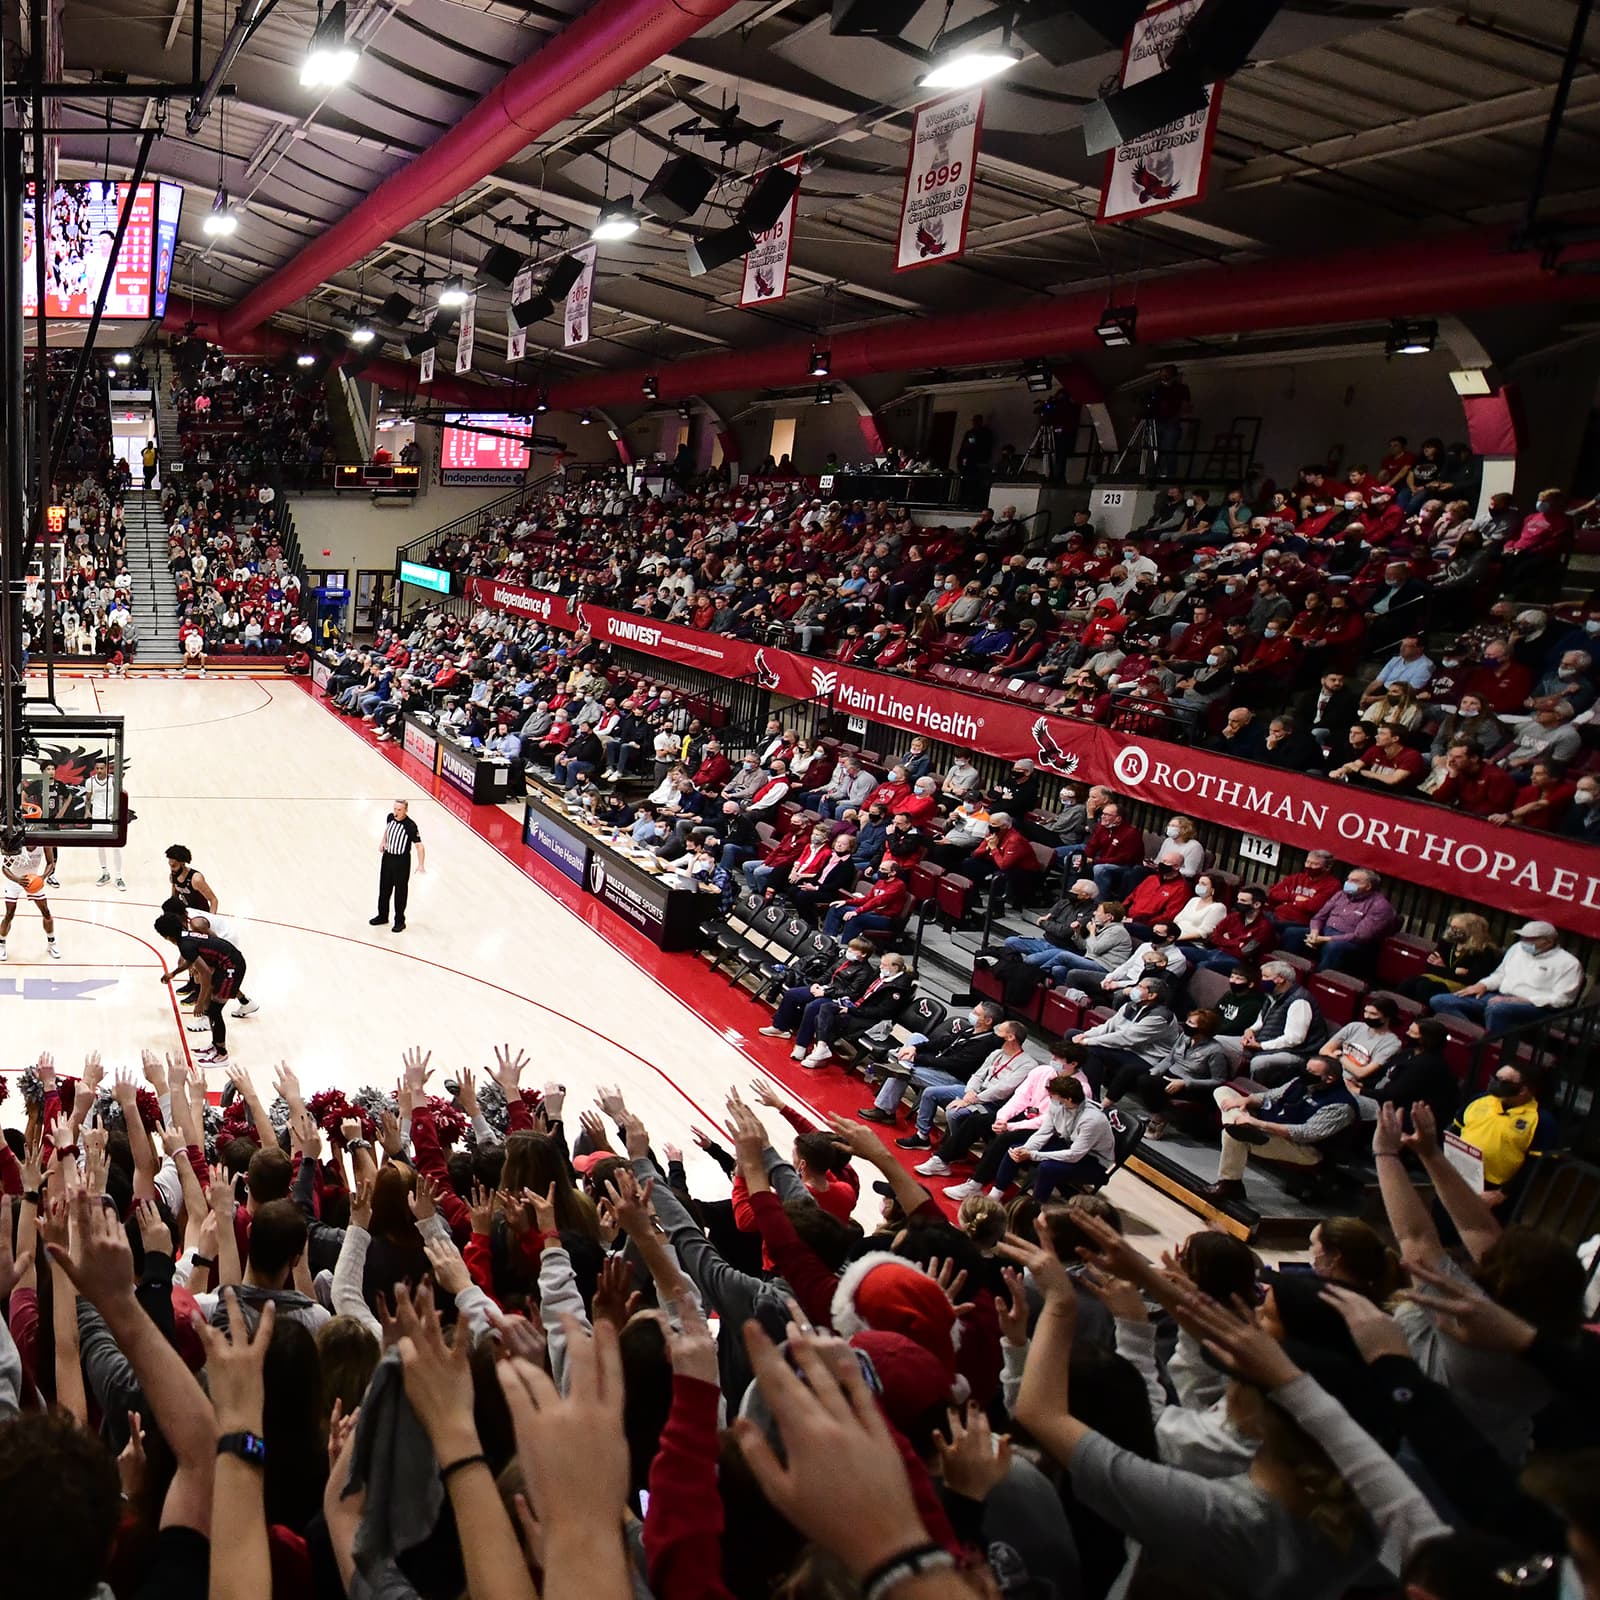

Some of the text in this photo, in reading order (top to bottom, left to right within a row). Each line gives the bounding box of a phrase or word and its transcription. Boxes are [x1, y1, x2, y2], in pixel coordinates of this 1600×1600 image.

[917, 113, 976, 144] BASKETBALL
[926, 103, 969, 128] WOMEN'S
[1118, 131, 1199, 163] CHAMPIONS
[917, 161, 962, 193] 1999
[907, 183, 967, 212] ATLANTIC 10
[908, 199, 963, 224] CHAMPIONS
[753, 221, 783, 244] 2013
[395, 467, 418, 475] TEMPLE
[444, 473, 513, 486] Independence
[1104, 494, 1121, 505] 213
[493, 587, 541, 613] Independence
[616, 621, 662, 647] UNIVEST
[838, 683, 875, 712] Main
[878, 694, 914, 723] Line
[852, 716, 864, 729] 113
[448, 754, 476, 787] UNIVEST
[1153, 761, 1329, 831] ROTHMAN
[538, 829, 584, 873] Main Line Health
[1246, 837, 1275, 857] 114
[606, 873, 664, 920] VALLEY FORGE SPORTS
